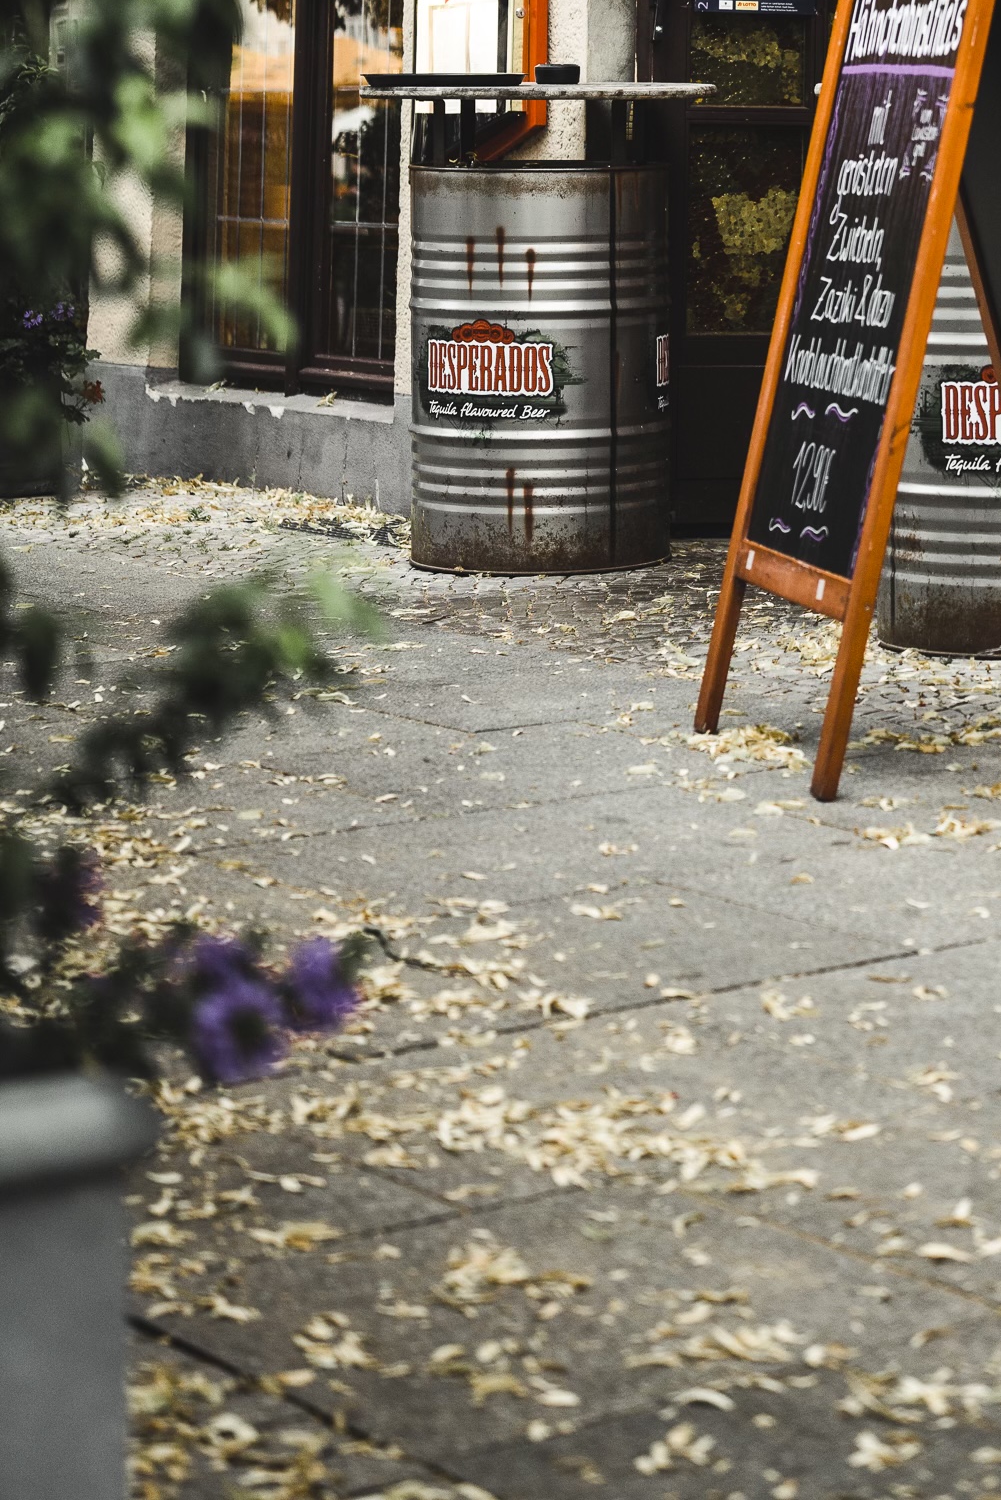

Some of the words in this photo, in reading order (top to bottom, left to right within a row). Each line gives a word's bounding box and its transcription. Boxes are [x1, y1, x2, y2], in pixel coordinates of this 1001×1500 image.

[810, 276, 858, 324] Zaziki
[429, 340, 552, 395] DESPERADOS
[429, 400, 458, 421] Tequila
[520, 405, 551, 418] Beer
[945, 454, 991, 476] Tequila
